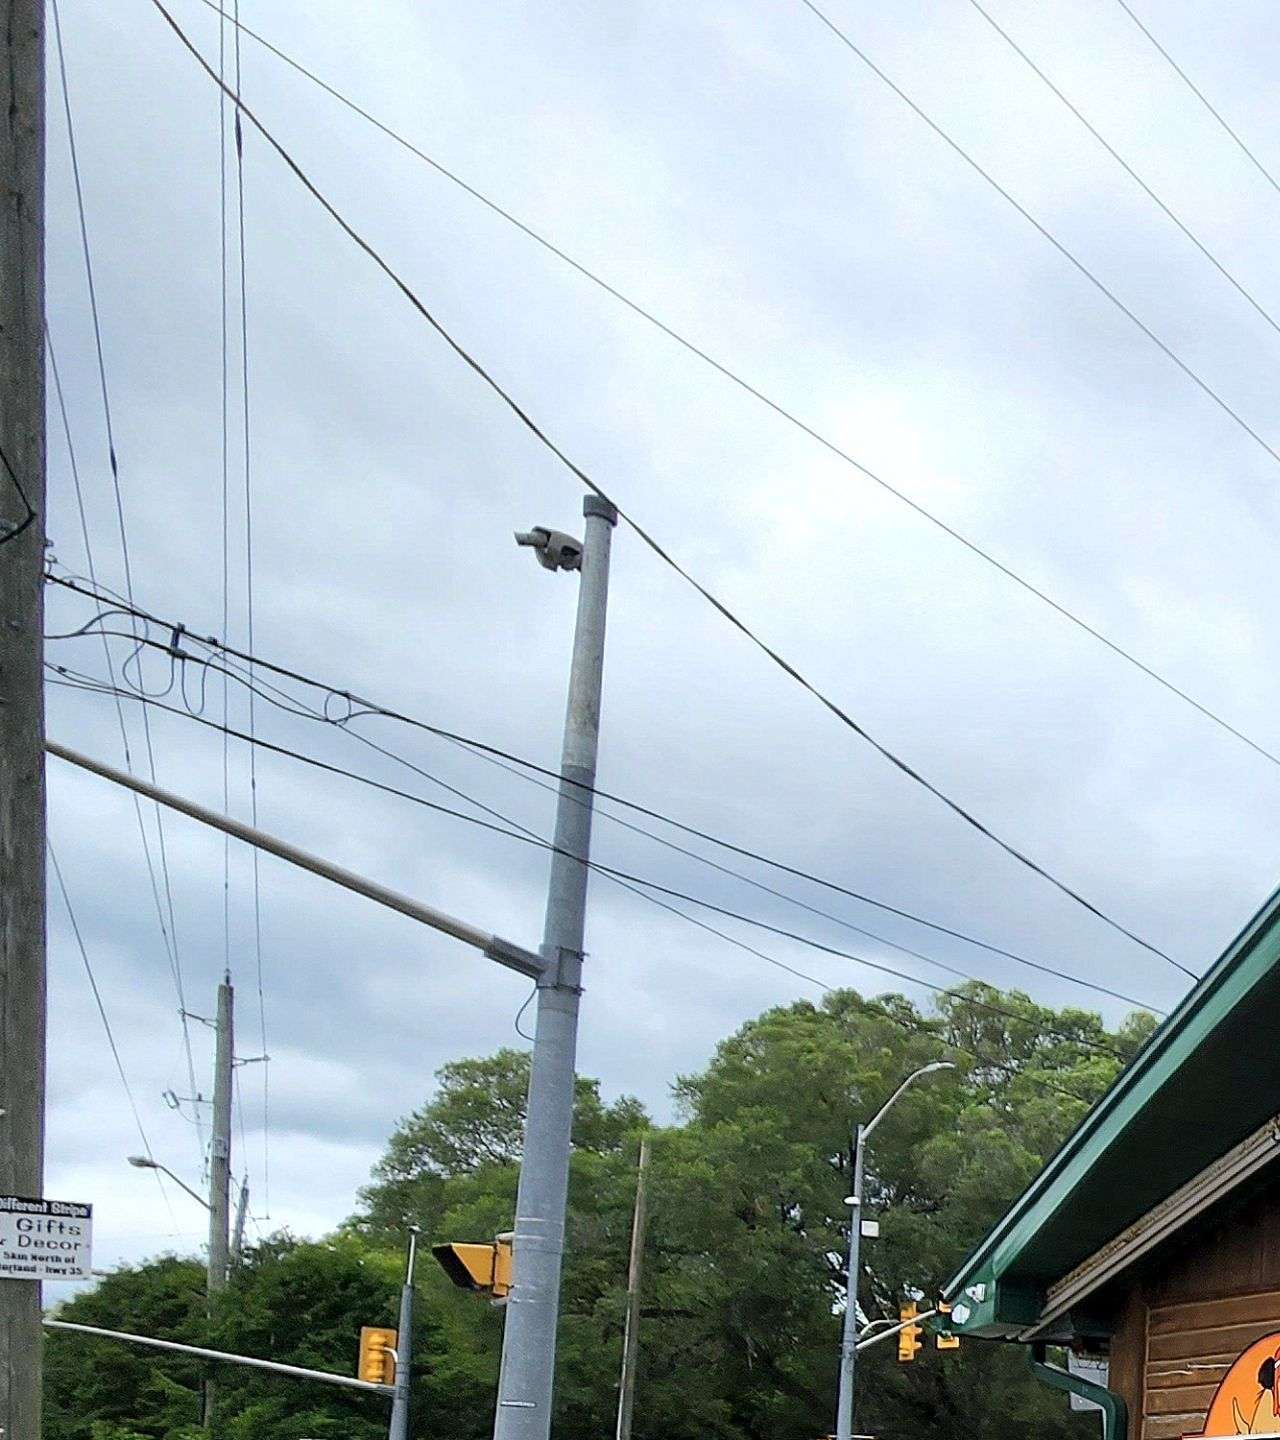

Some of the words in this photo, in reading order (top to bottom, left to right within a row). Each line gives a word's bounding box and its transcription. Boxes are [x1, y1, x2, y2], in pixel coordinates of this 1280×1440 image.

[16, 1217, 81, 1235] Gifts
[18, 1234, 81, 1250] Decor
[0, 1264, 37, 1273] orland
